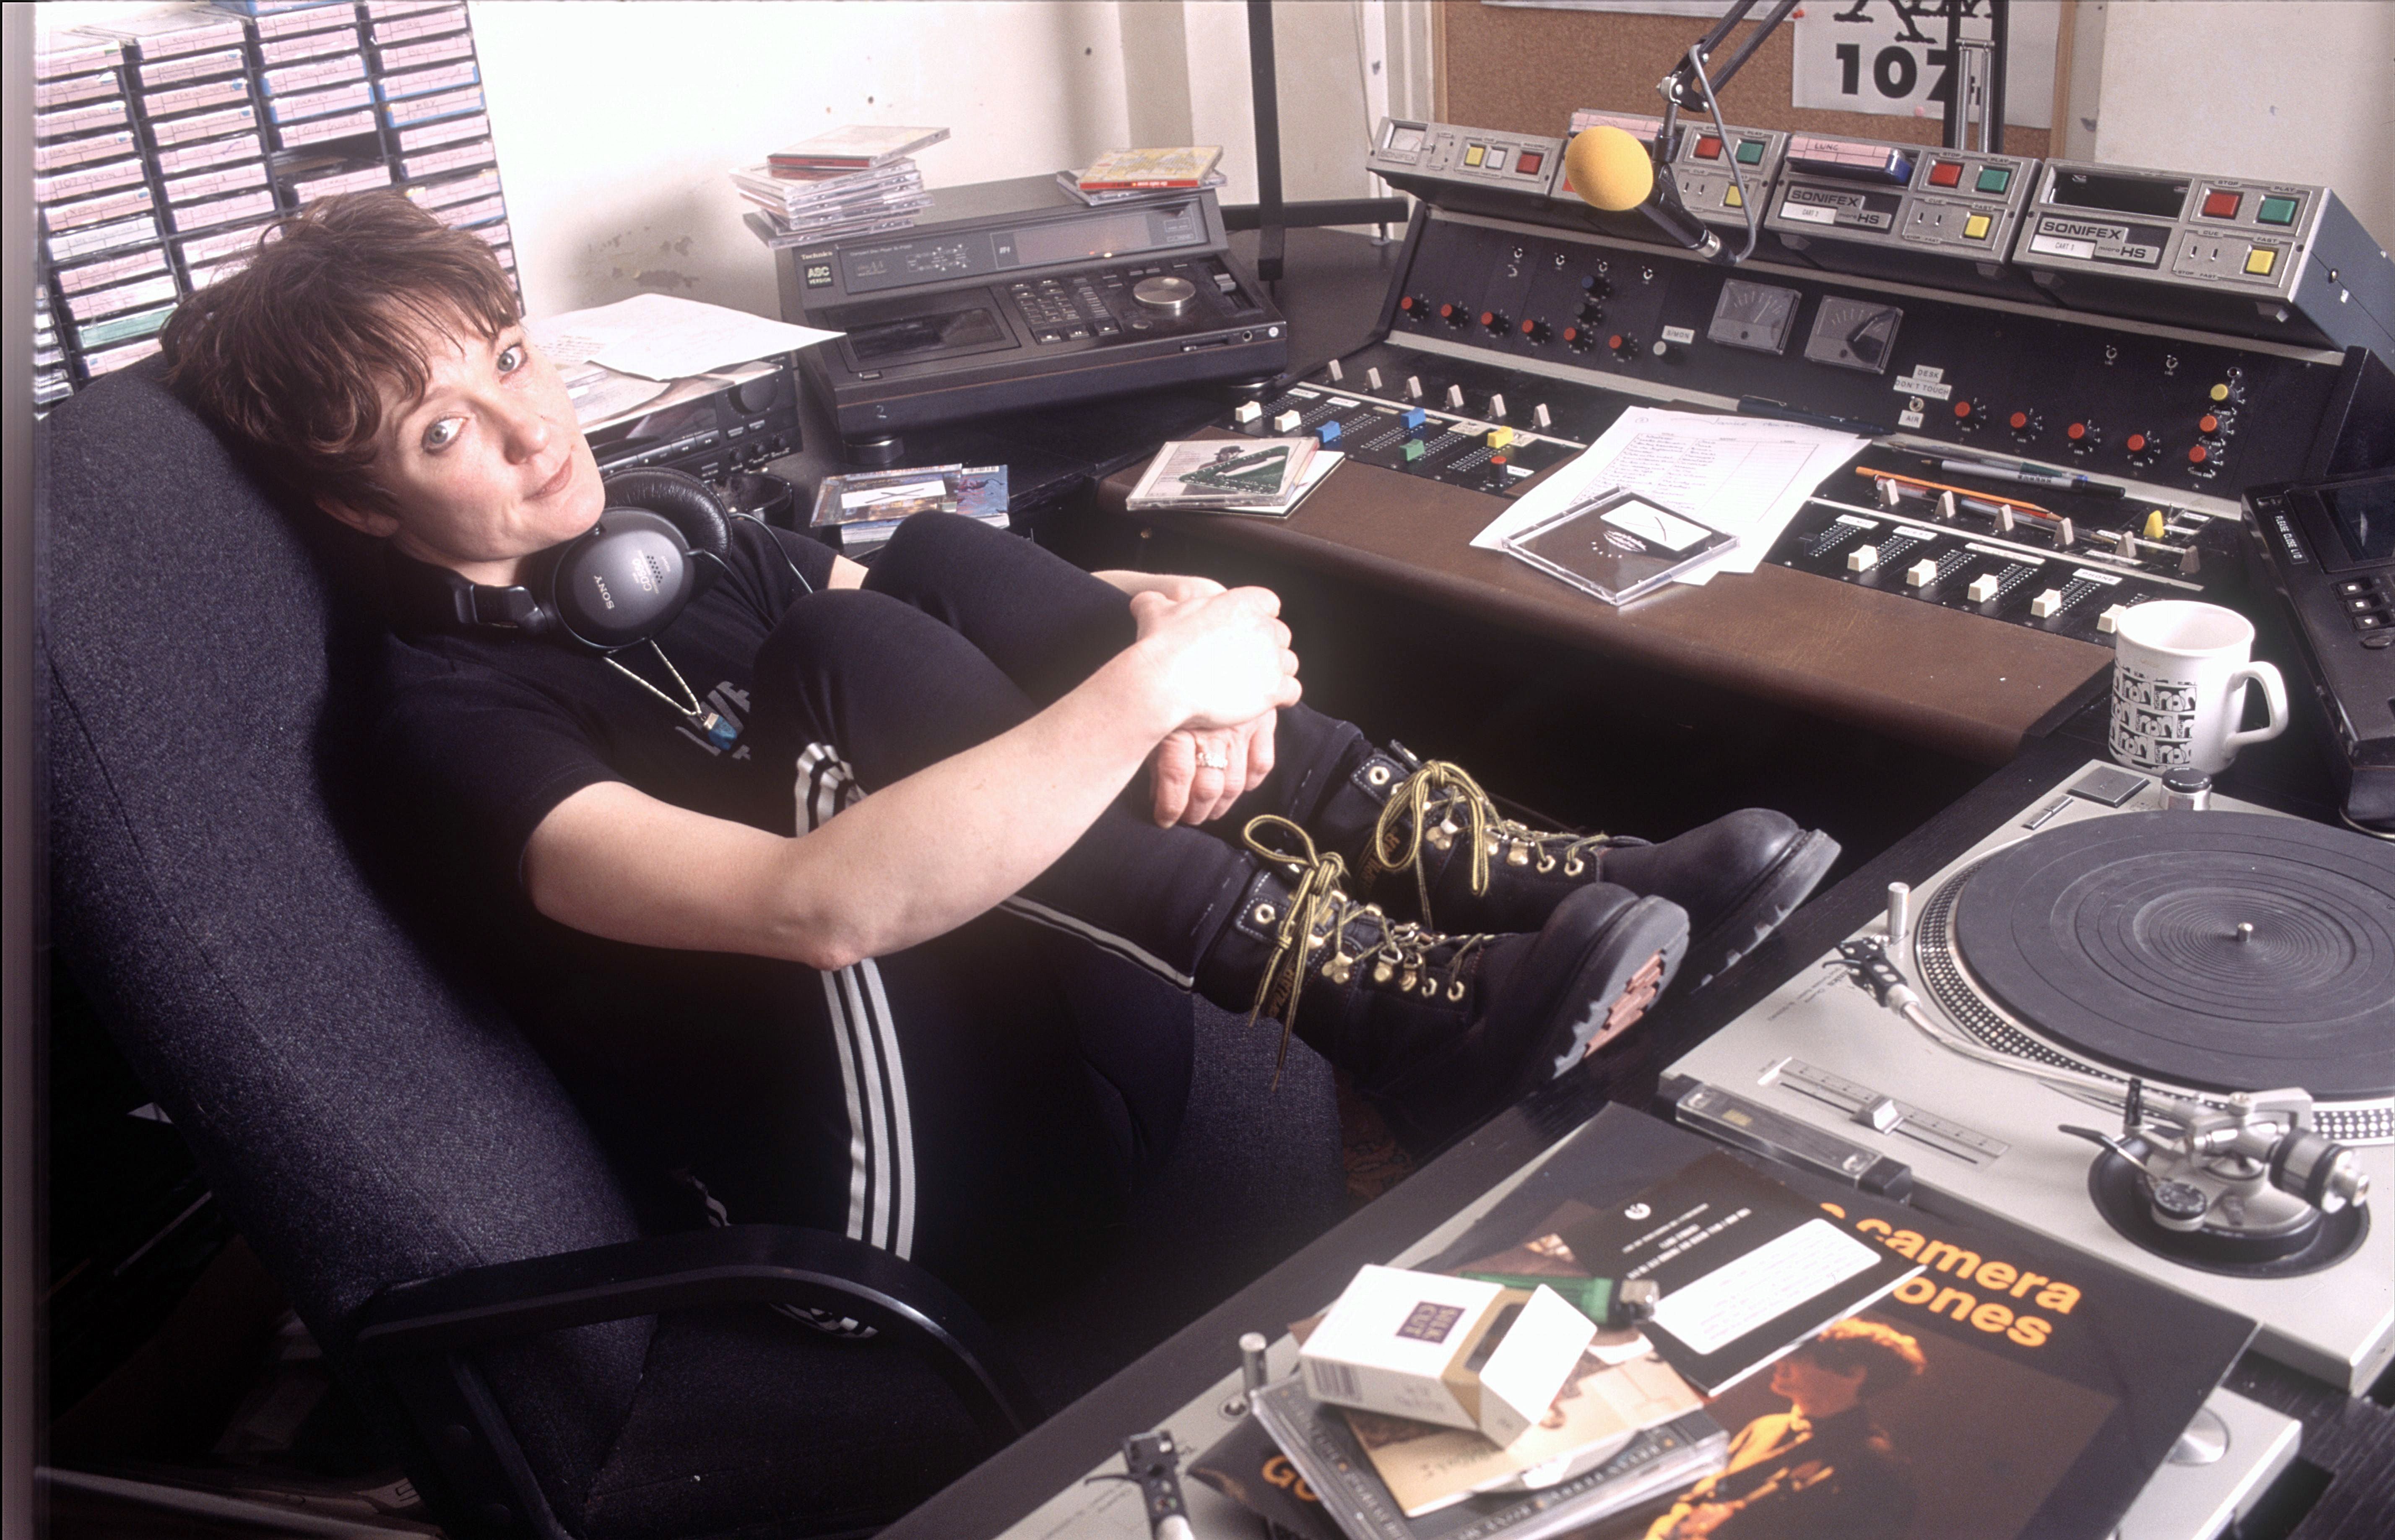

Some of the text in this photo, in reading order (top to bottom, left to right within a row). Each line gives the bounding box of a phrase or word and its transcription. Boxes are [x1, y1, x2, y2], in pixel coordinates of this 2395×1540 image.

[1792, 190, 1859, 207] SONIFEX
[1857, 213, 1880, 224] HS
[2044, 221, 2122, 239] SONIFEX
[801, 251, 833, 260] Technics
[2120, 247, 2146, 258] HS
[808, 266, 830, 278] ASC
[1917, 369, 1940, 378] DESK
[1895, 380, 1948, 395] DON'T TOUCH
[2275, 515, 2303, 559] PLEASE CLOSE LID
[2082, 572, 2114, 582] PHONE
[593, 575, 615, 609] SONY
[1856, 1218, 2082, 1314] camera
[1892, 1276, 2053, 1348] ones
